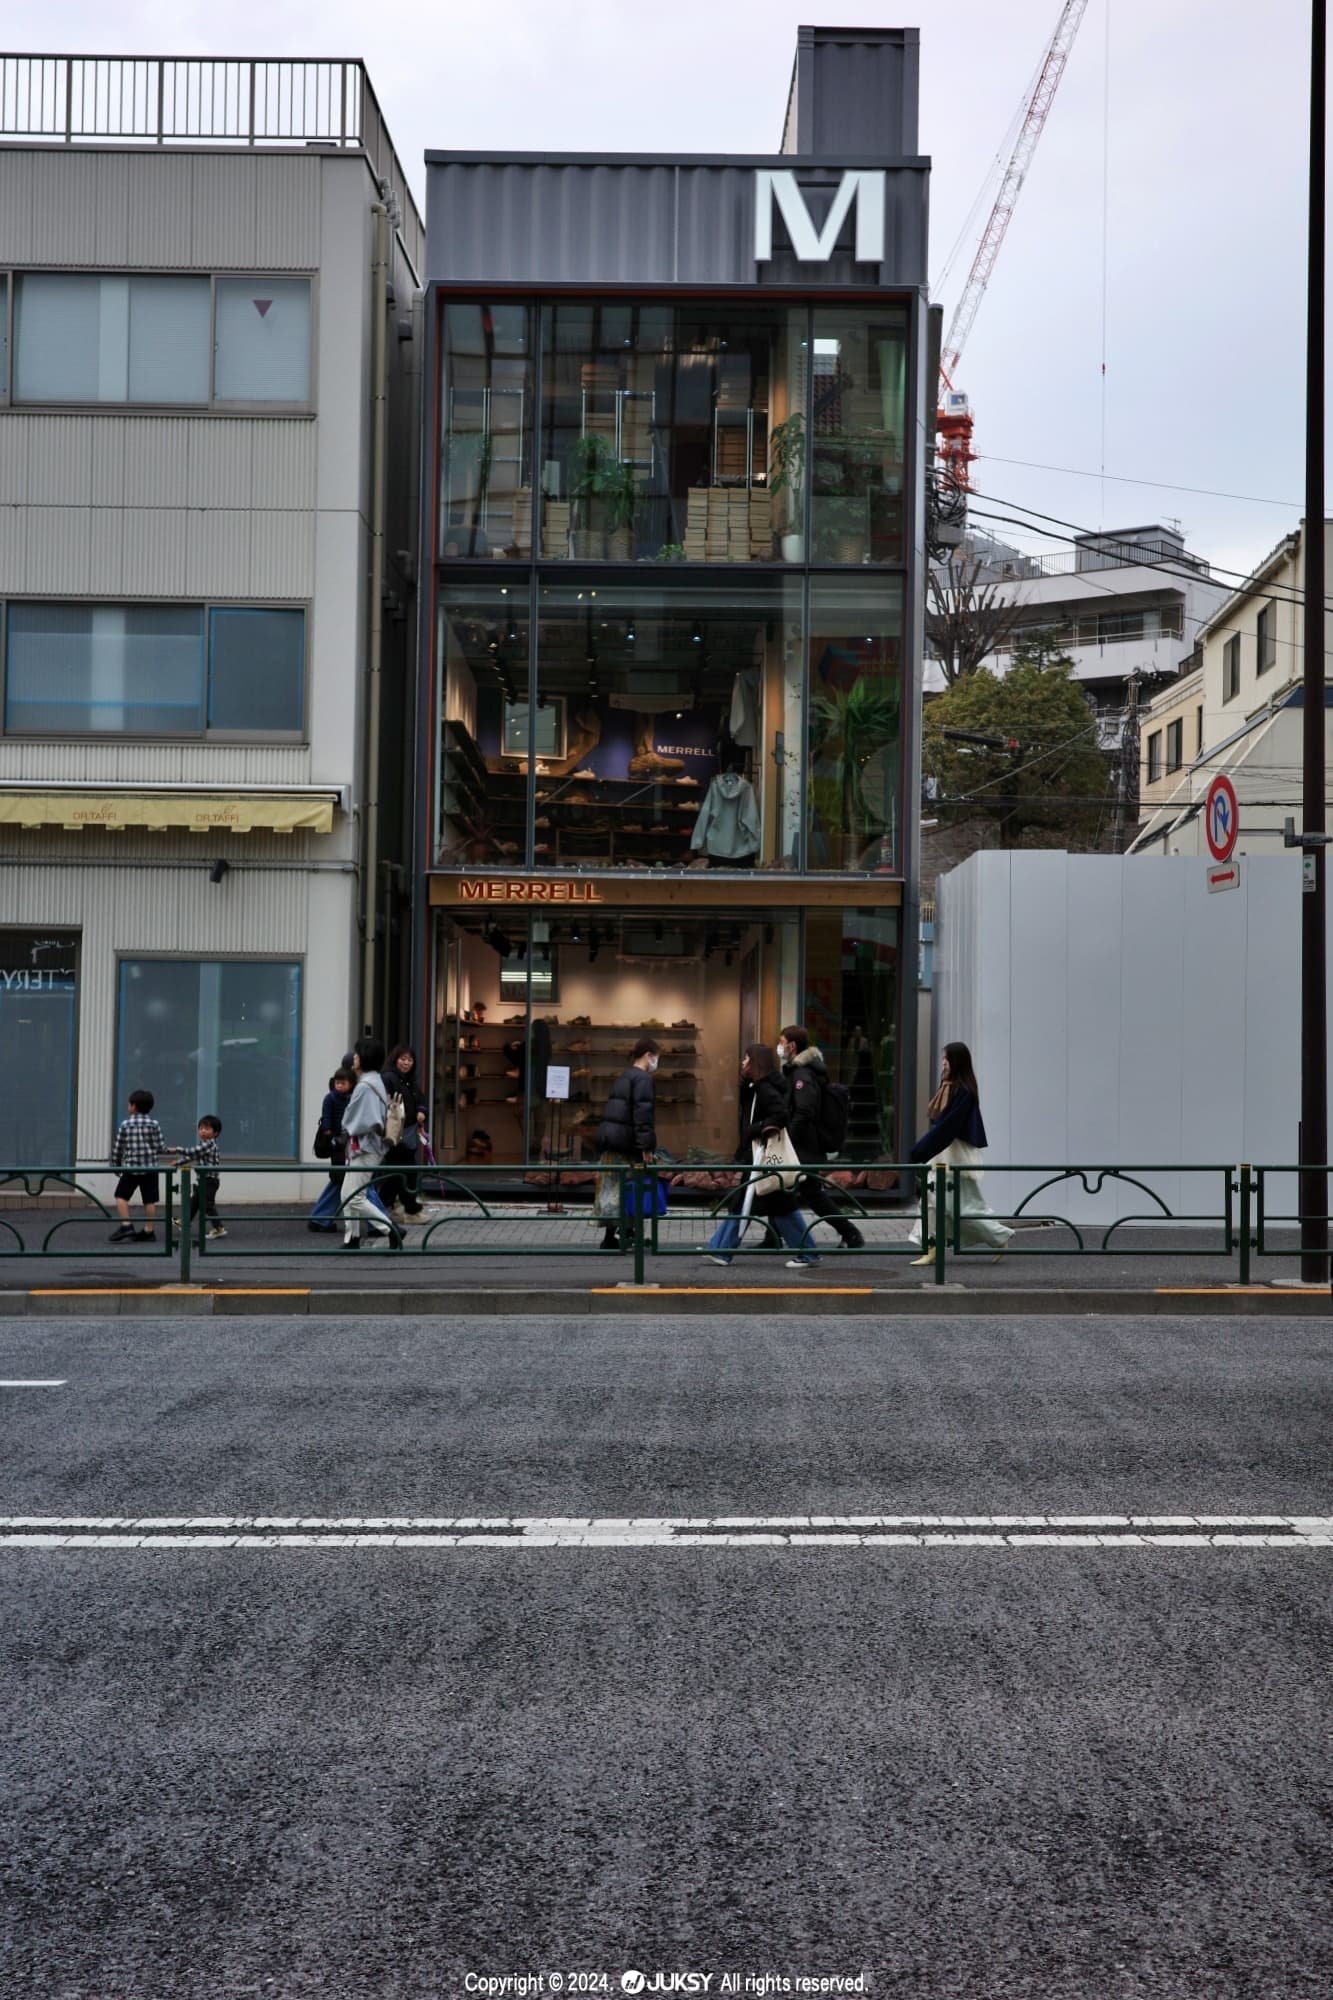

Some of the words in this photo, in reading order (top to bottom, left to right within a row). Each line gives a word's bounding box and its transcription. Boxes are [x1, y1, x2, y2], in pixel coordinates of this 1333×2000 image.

[755, 169, 886, 262] M
[657, 745, 715, 757] MERRELL
[459, 879, 603, 902] MERRELL
